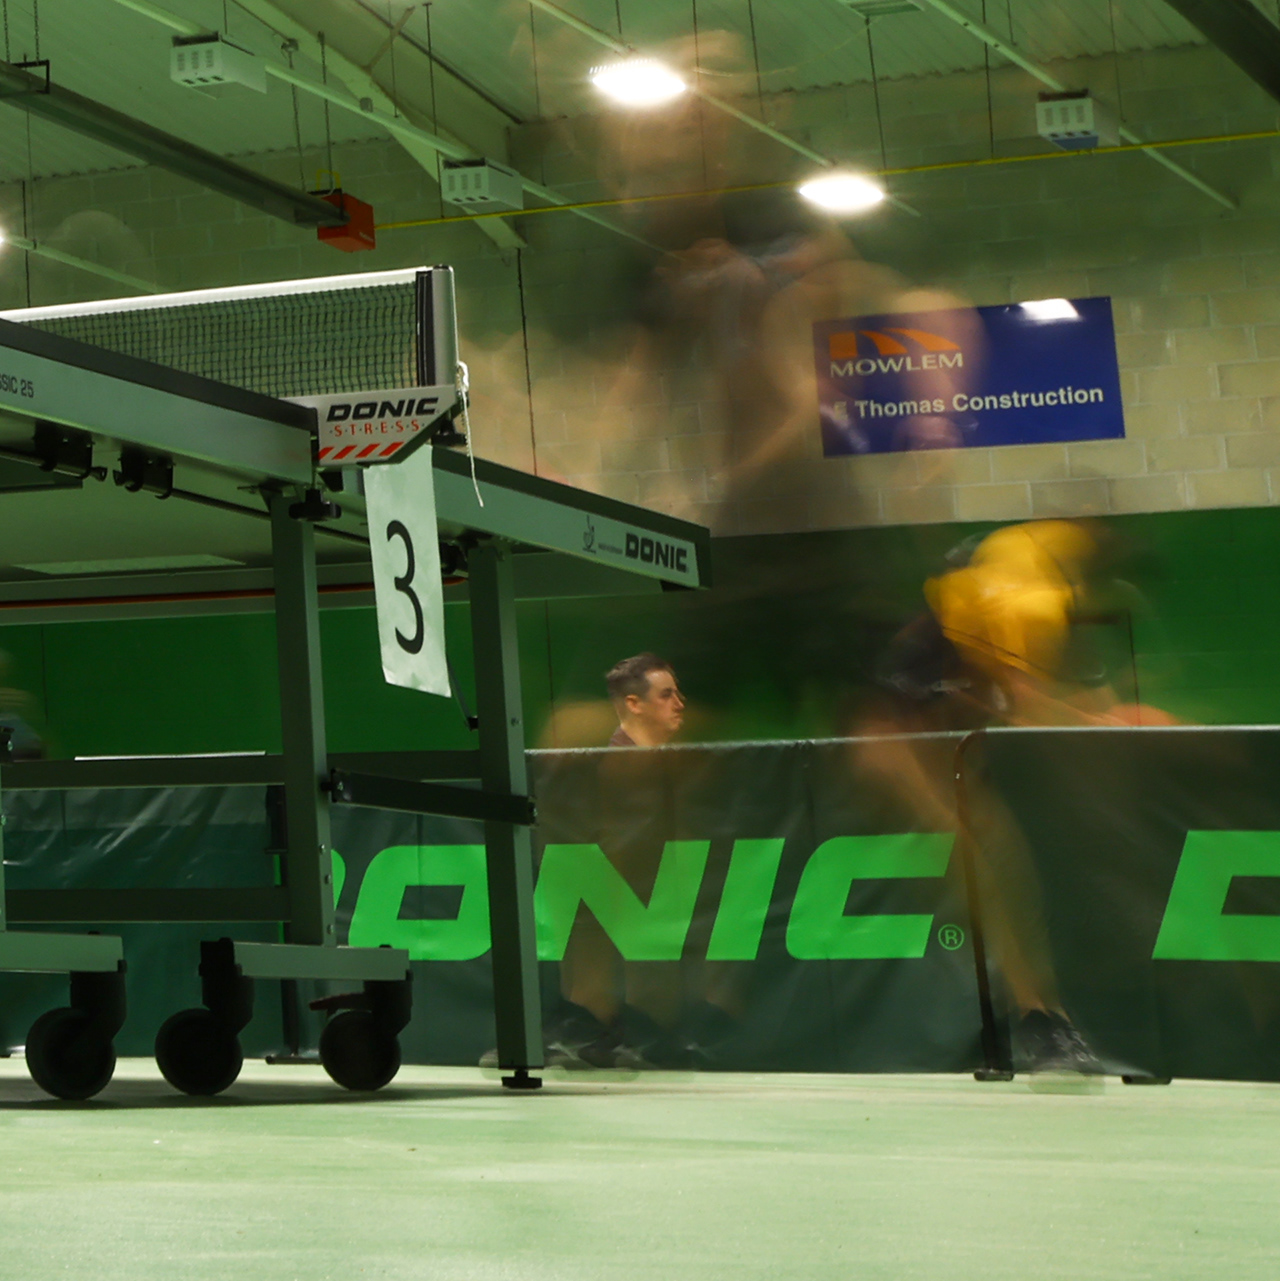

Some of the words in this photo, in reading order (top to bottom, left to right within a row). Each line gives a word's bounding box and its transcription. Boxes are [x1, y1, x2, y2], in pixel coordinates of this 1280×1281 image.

[830, 352, 963, 378] MOWLEM
[20, 378, 34, 398] 25
[853, 398, 945, 419] Thomas
[951, 385, 1104, 412] Construction
[326, 397, 439, 422] DONIC
[625, 532, 688, 574] DONIC
[386, 520, 424, 655] 3
